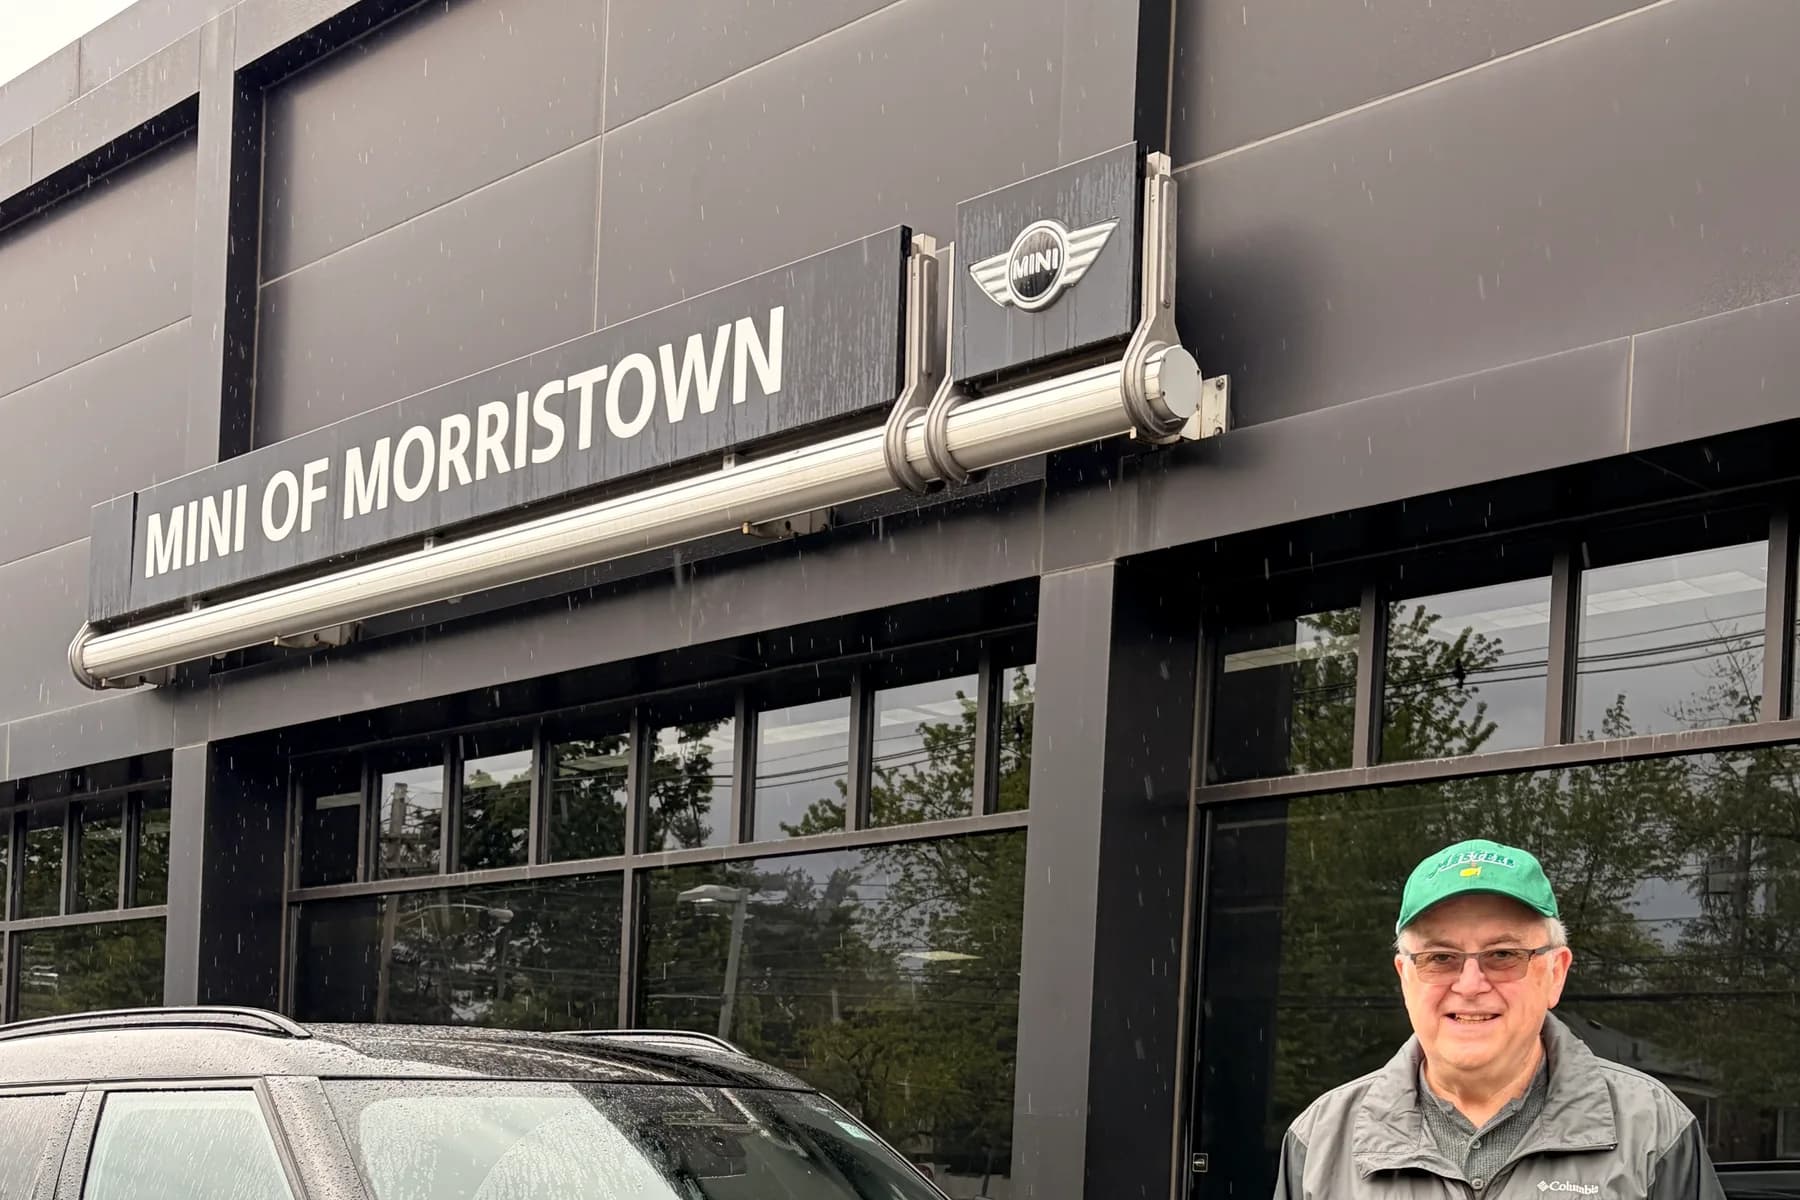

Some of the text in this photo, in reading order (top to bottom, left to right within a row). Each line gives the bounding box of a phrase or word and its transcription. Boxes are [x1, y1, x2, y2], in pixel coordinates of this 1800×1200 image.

[1012, 247, 1059, 280] MINI
[145, 305, 785, 579] MINI OF MORRISTOWN
[1428, 850, 1515, 879] MASTERS
[1549, 1180, 1599, 1195] Columbia
